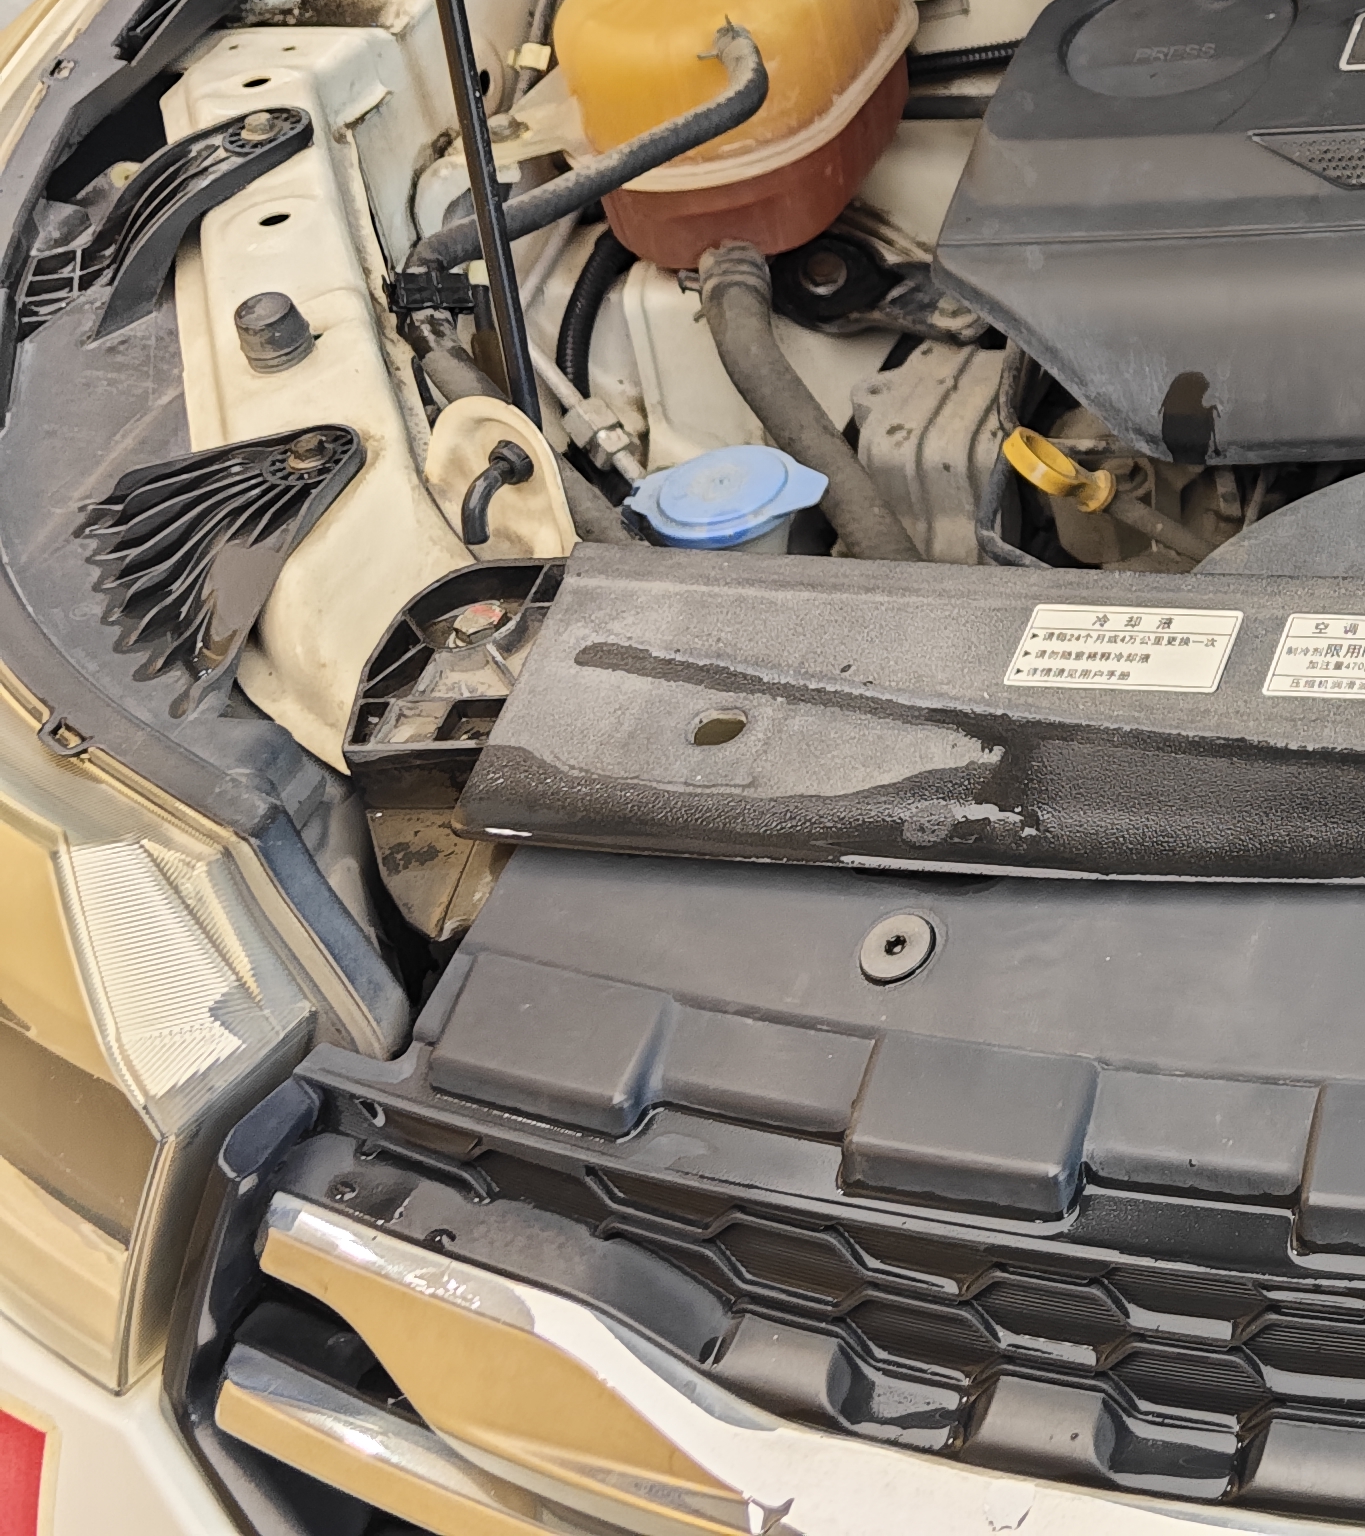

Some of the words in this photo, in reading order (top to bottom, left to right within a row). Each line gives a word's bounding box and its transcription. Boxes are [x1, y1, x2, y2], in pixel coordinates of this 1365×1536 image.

[1133, 42, 1216, 64] PRESS
[1091, 614, 1175, 629] 冷却液
